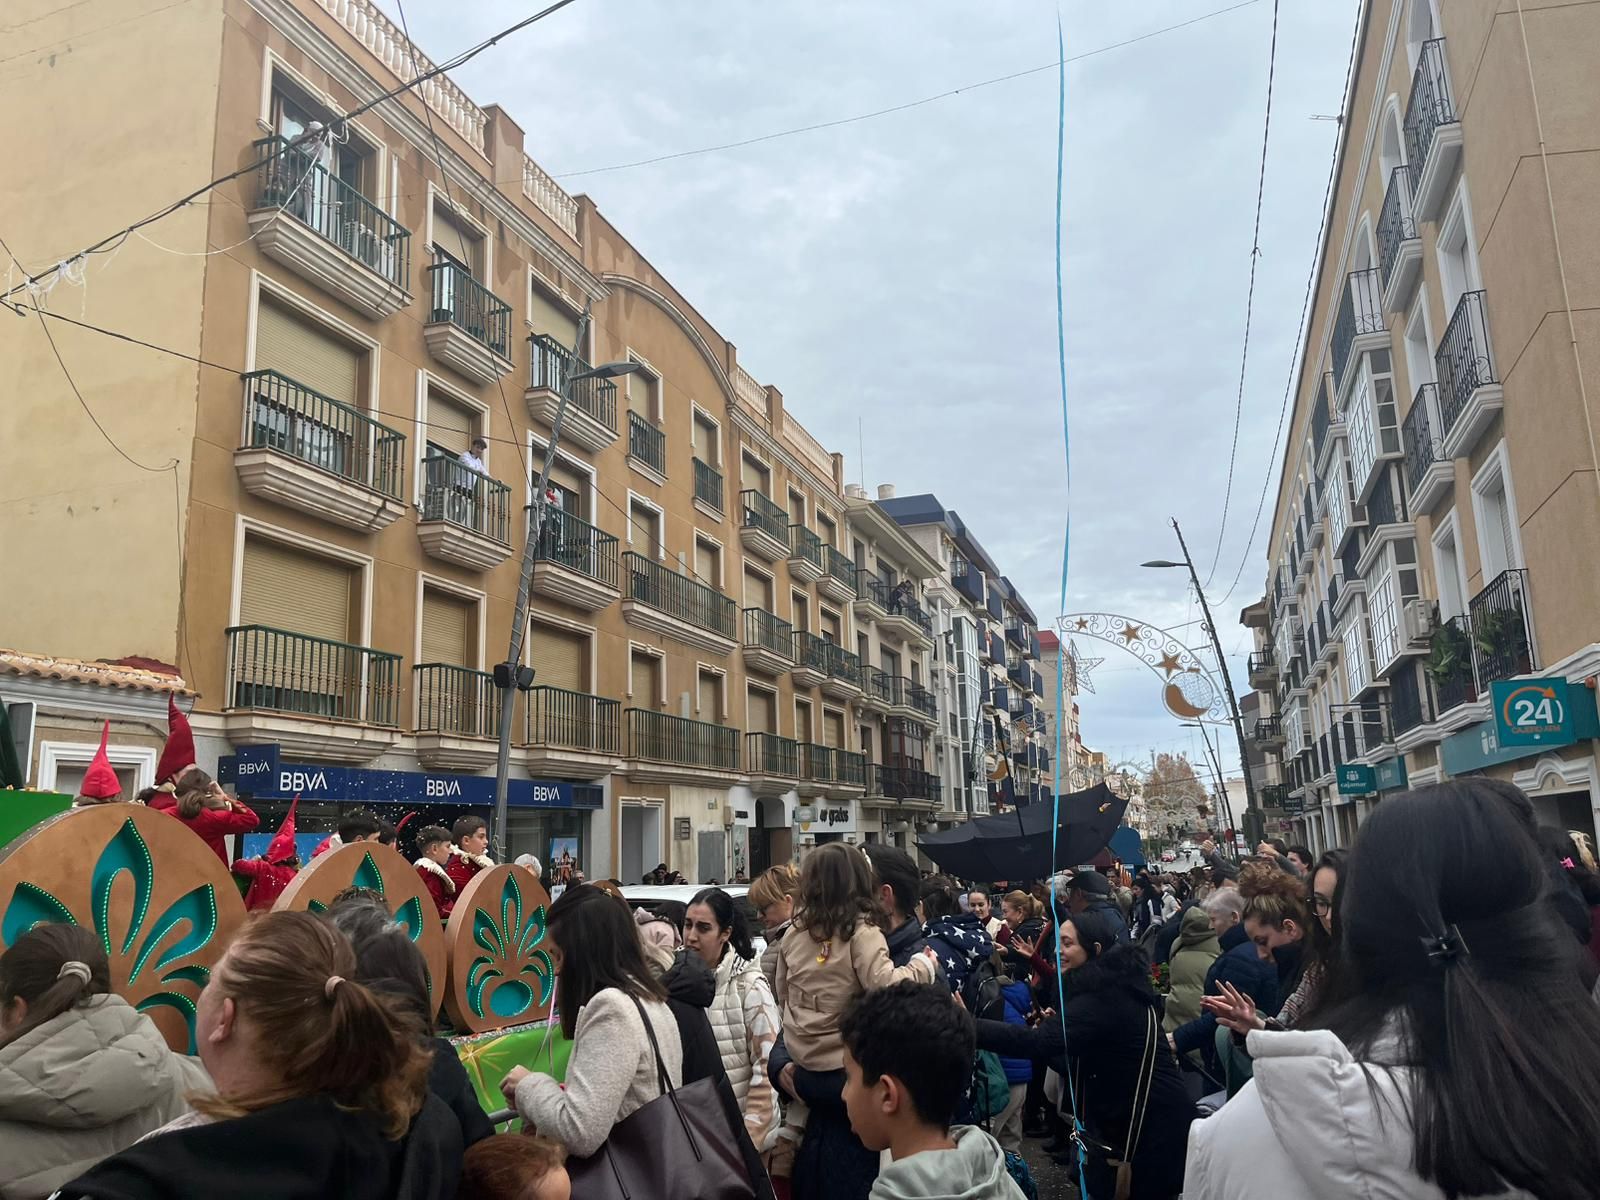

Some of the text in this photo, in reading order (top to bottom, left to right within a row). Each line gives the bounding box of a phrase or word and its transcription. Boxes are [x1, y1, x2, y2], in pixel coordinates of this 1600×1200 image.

[239, 761, 270, 775] BBVA
[280, 771, 328, 792] BBVA
[426, 779, 461, 797] BBVA
[1340, 781, 1367, 789] cajamar
[533, 786, 560, 801] BBVA
